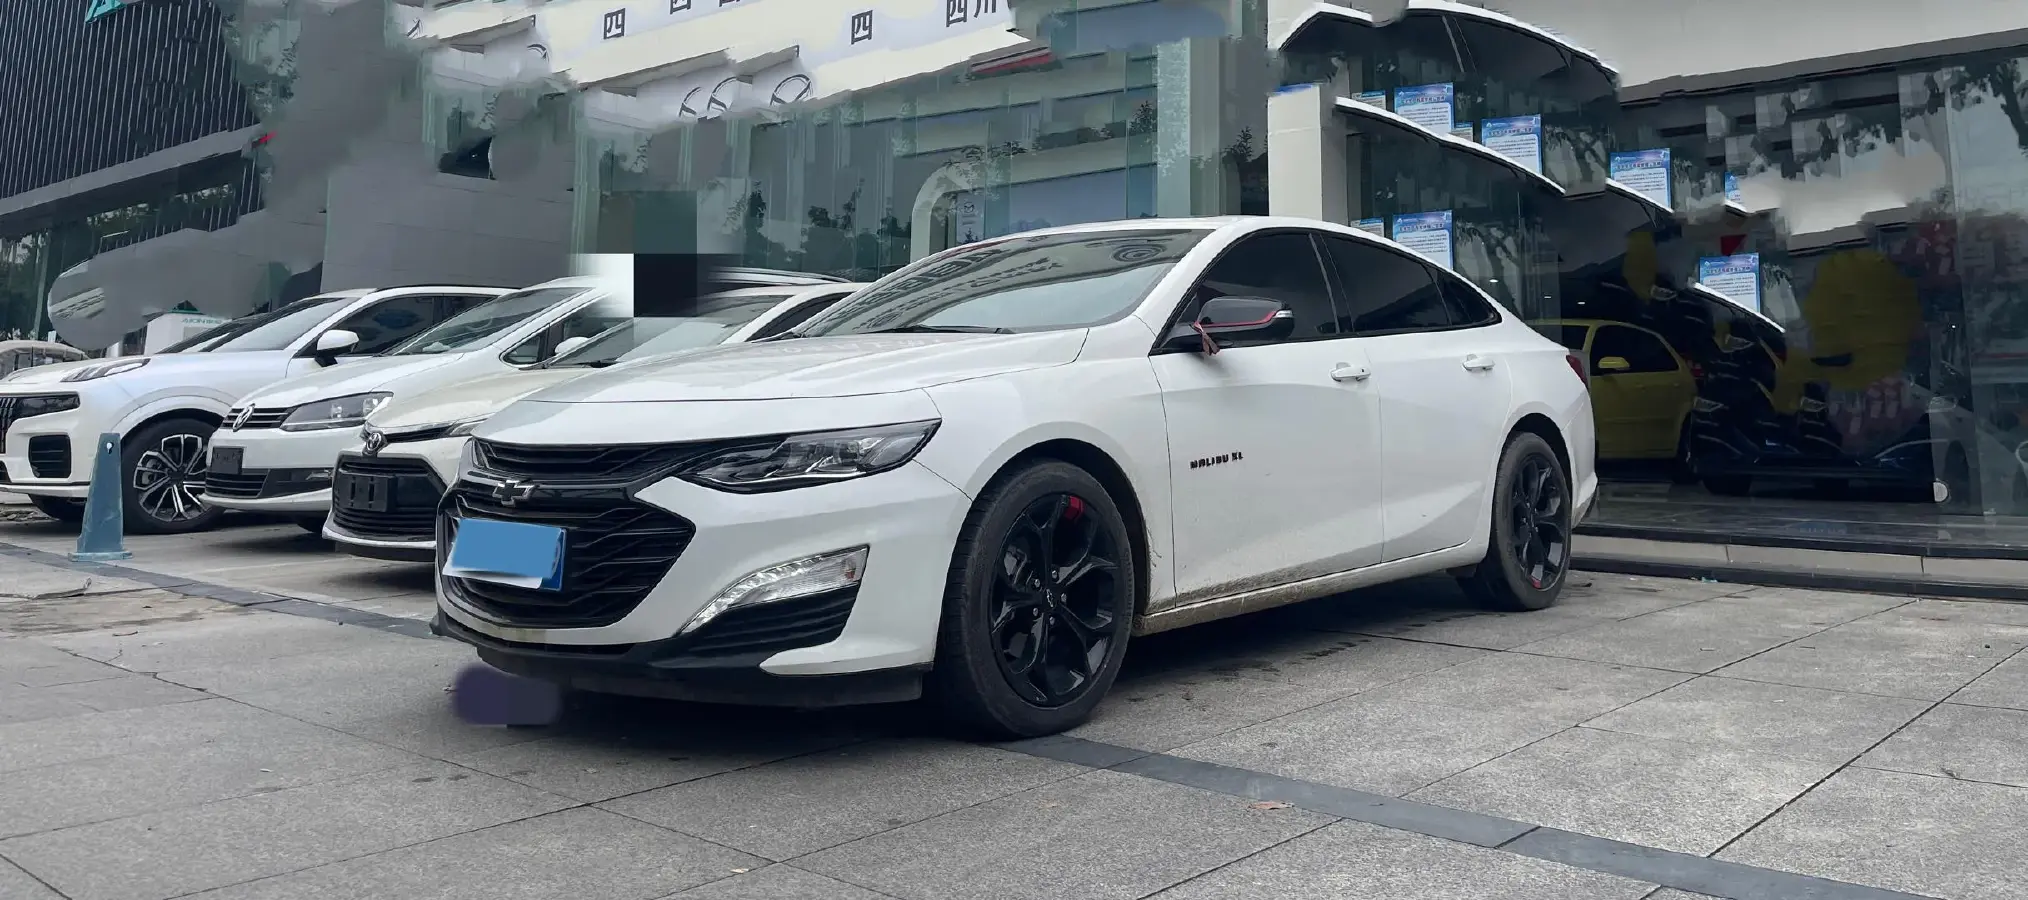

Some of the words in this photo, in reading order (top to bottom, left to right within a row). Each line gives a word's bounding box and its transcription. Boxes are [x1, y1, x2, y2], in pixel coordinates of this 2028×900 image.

[603, 8, 626, 40] 四
[851, 9, 873, 45] 四
[1190, 454, 1229, 470] MALIBU
